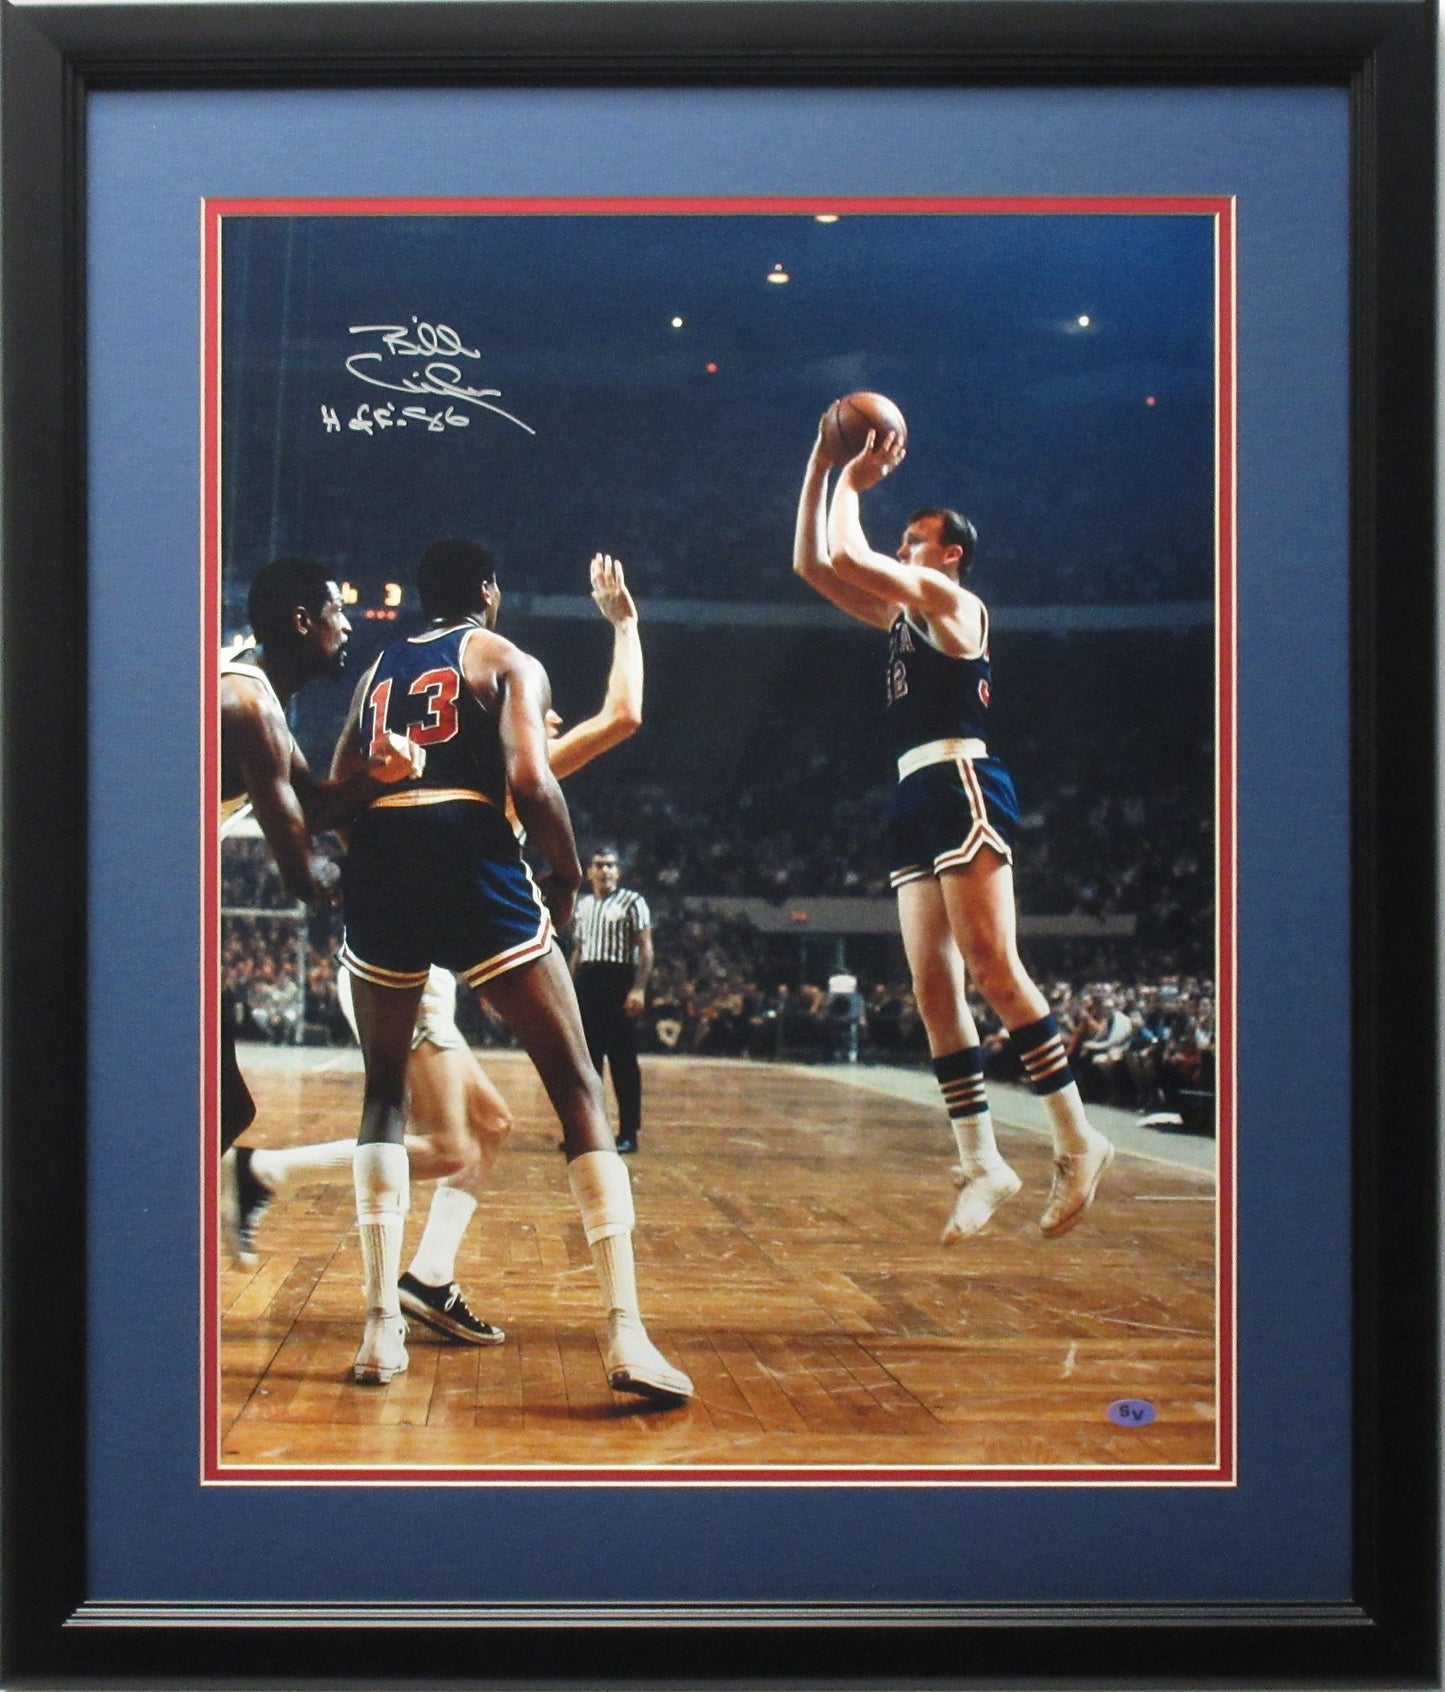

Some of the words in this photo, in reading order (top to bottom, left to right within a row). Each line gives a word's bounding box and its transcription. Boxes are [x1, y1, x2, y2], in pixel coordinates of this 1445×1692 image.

[349, 315, 481, 359] Bill
[384, 582, 402, 607] 3
[369, 667, 460, 757] 13
